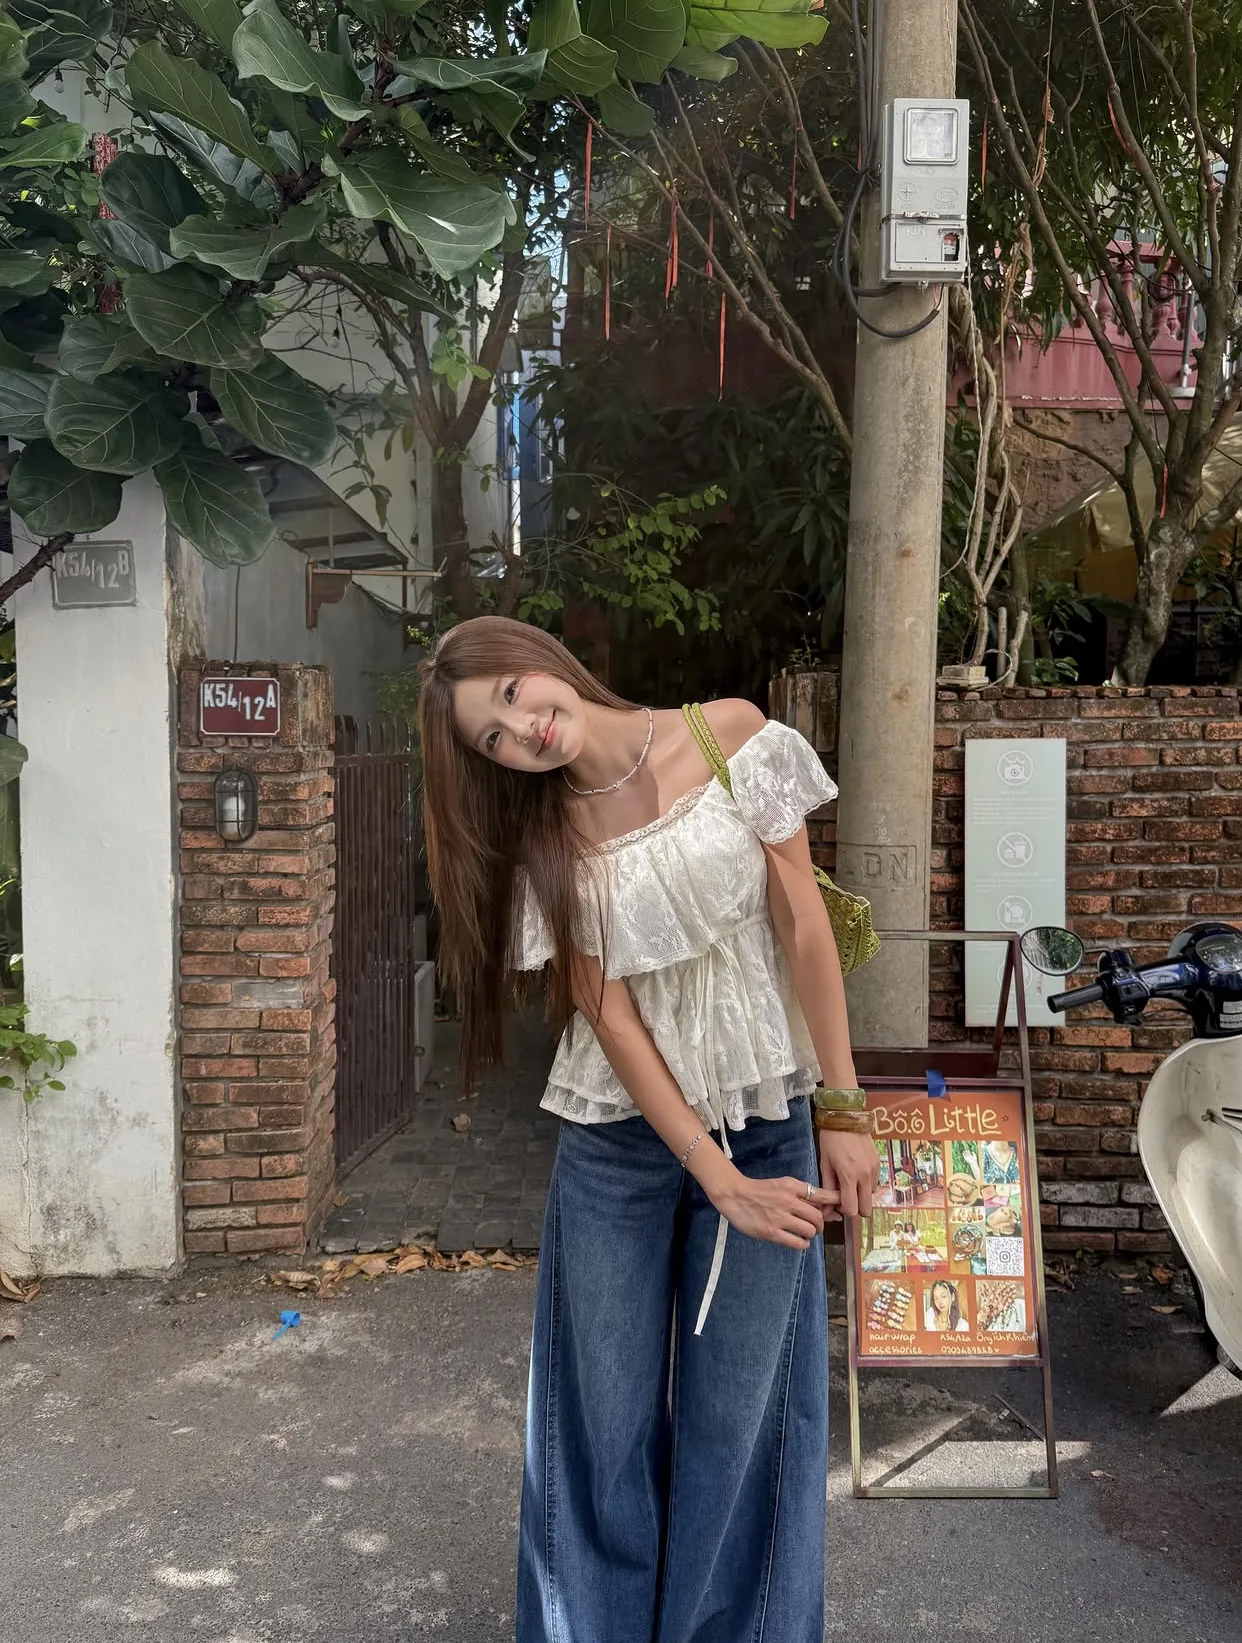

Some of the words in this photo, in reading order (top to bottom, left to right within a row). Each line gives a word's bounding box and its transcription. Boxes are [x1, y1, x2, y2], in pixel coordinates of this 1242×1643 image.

[204, 683, 276, 720] K54/12A
[869, 1331, 891, 1341] hair
[891, 1332, 916, 1345] wrap
[869, 1345, 922, 1354] accessories
